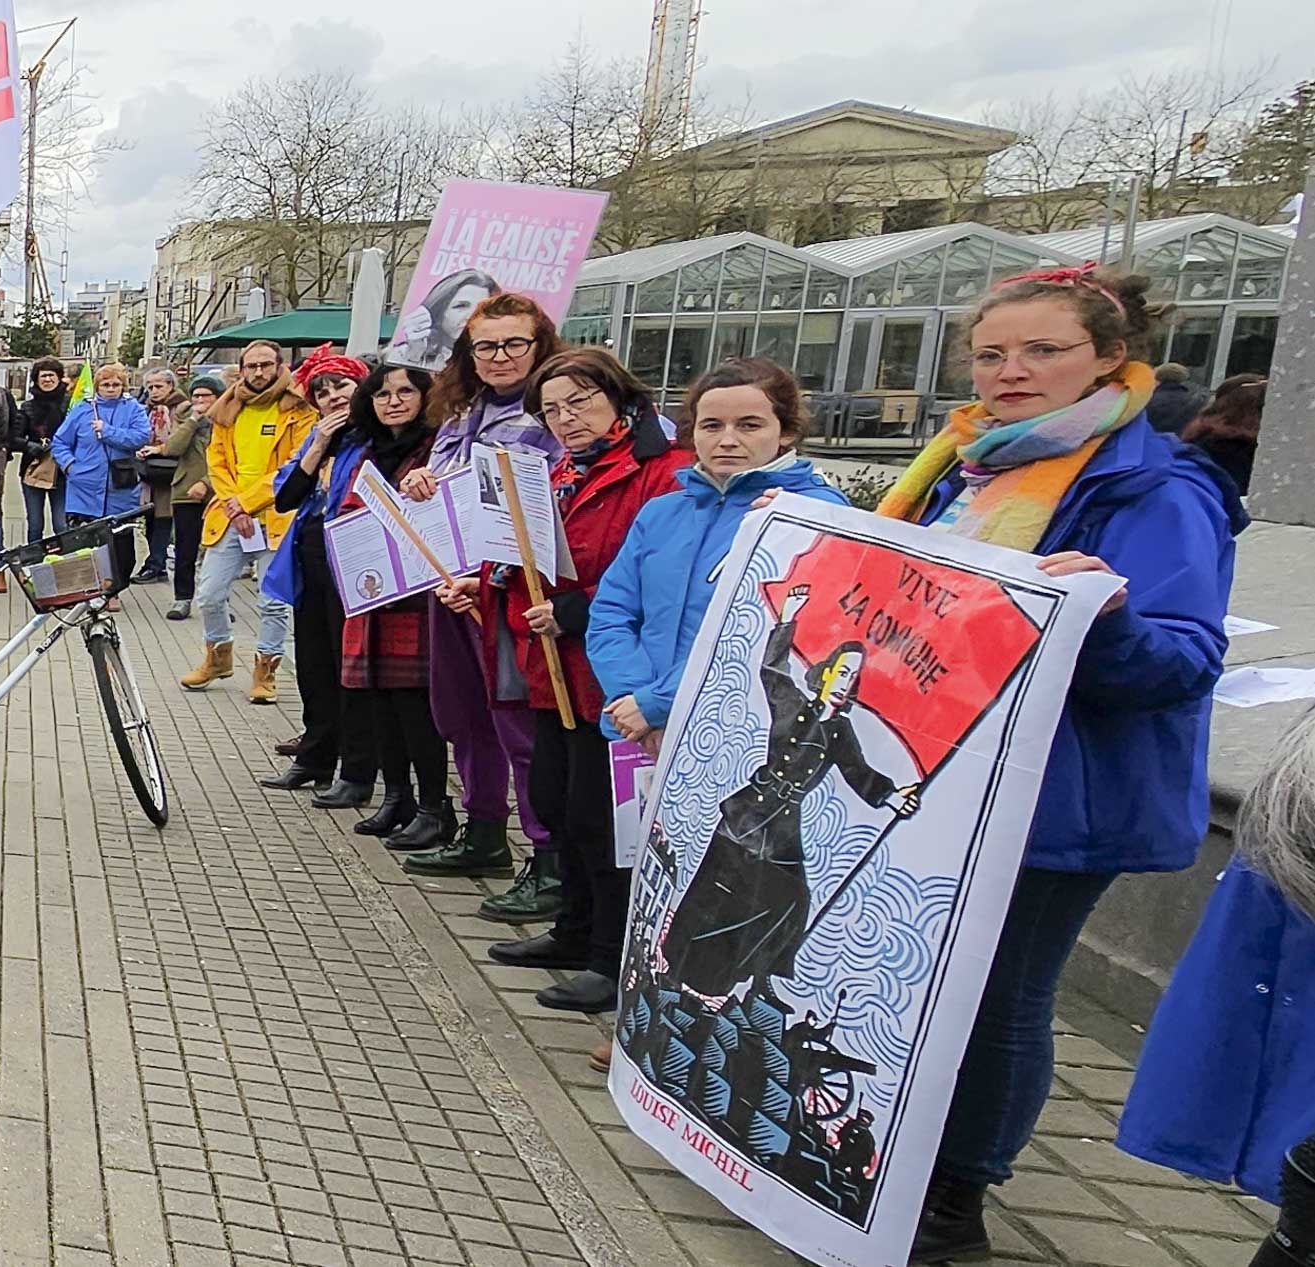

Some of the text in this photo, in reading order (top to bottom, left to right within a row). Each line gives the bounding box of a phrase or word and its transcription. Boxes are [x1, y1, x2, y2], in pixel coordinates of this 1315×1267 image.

[439, 214, 579, 267] LA CAUSE
[430, 251, 567, 294] DES FEMMES
[898, 561, 960, 619] VIVE
[838, 582, 949, 695] LA COMMUNE
[630, 1077, 754, 1193] LOUISE MICHEL
